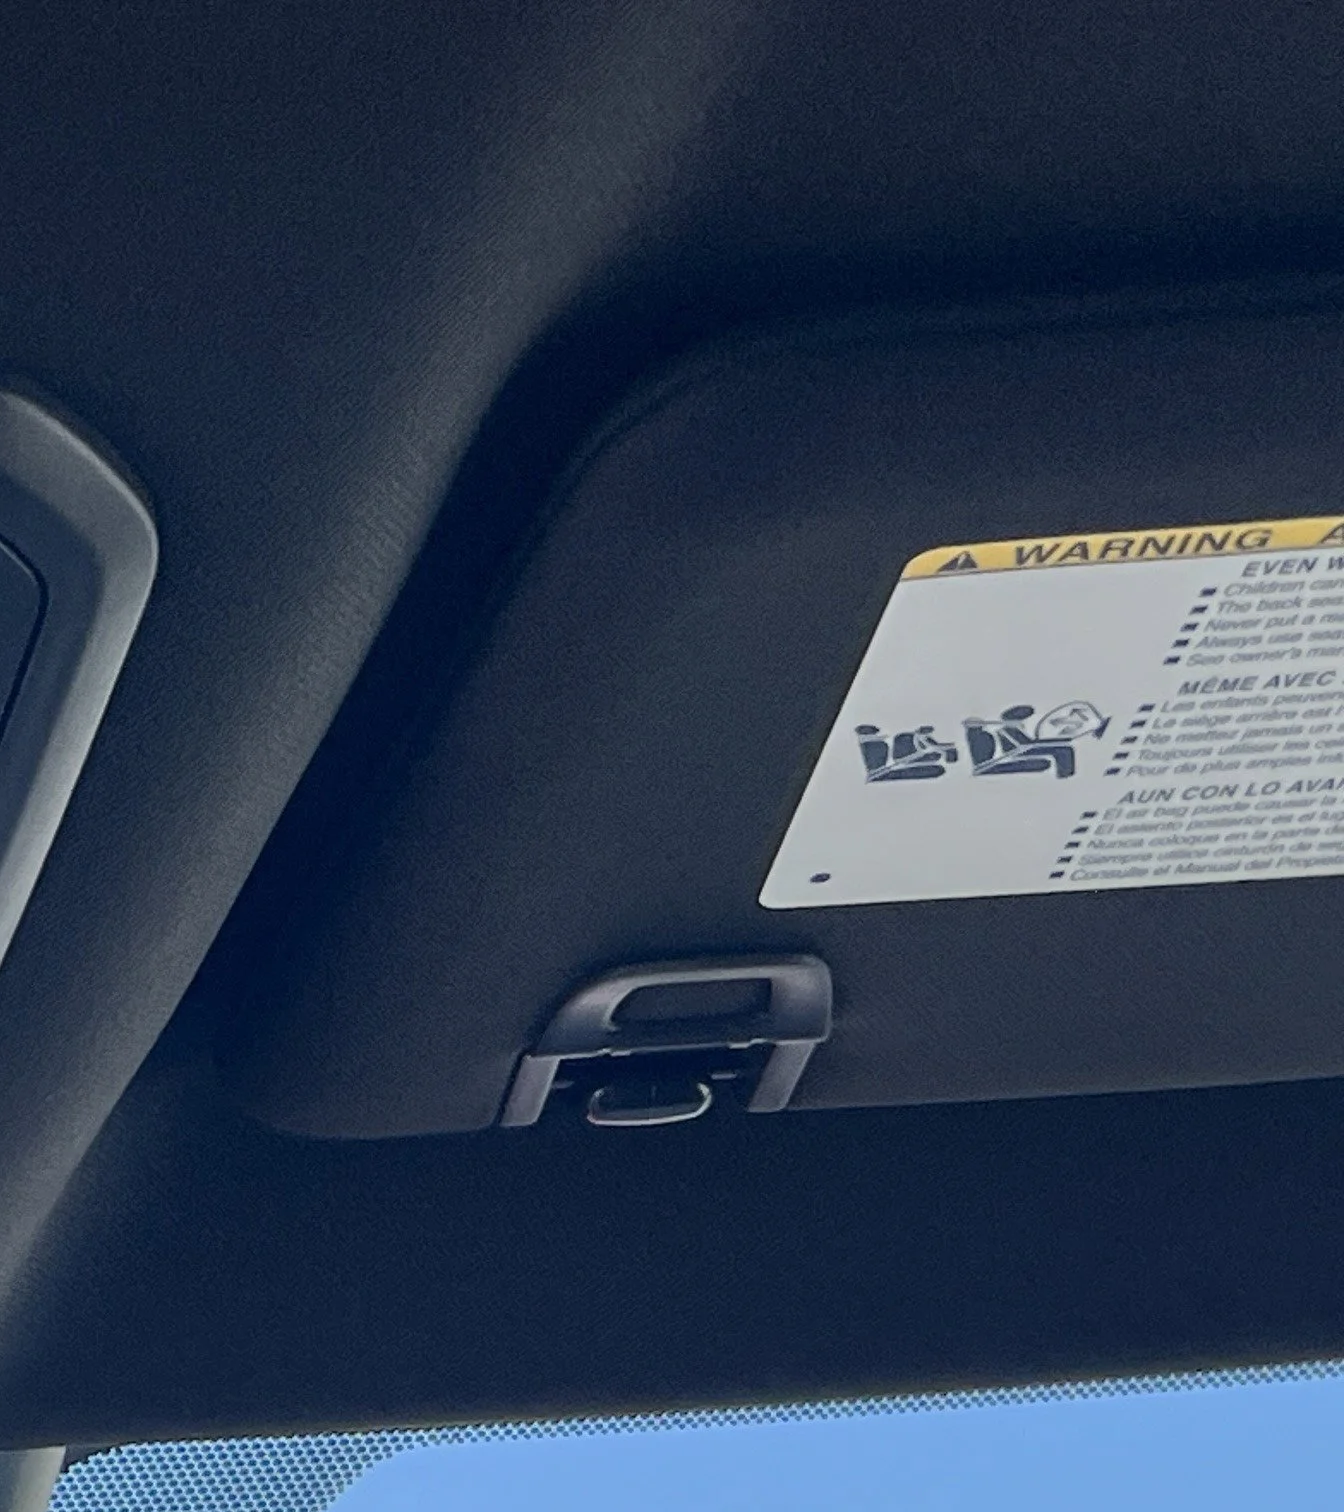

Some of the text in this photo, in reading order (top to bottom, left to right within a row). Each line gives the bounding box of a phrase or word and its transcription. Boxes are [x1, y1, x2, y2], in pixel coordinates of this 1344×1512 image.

[1014, 528, 1273, 566] WARNING
[1240, 557, 1319, 577] EVEN
[1177, 670, 1337, 695] MÊME AVEC
[1117, 787, 1176, 805] AUN
[1181, 783, 1239, 800] CON
[1244, 781, 1282, 797] LO
